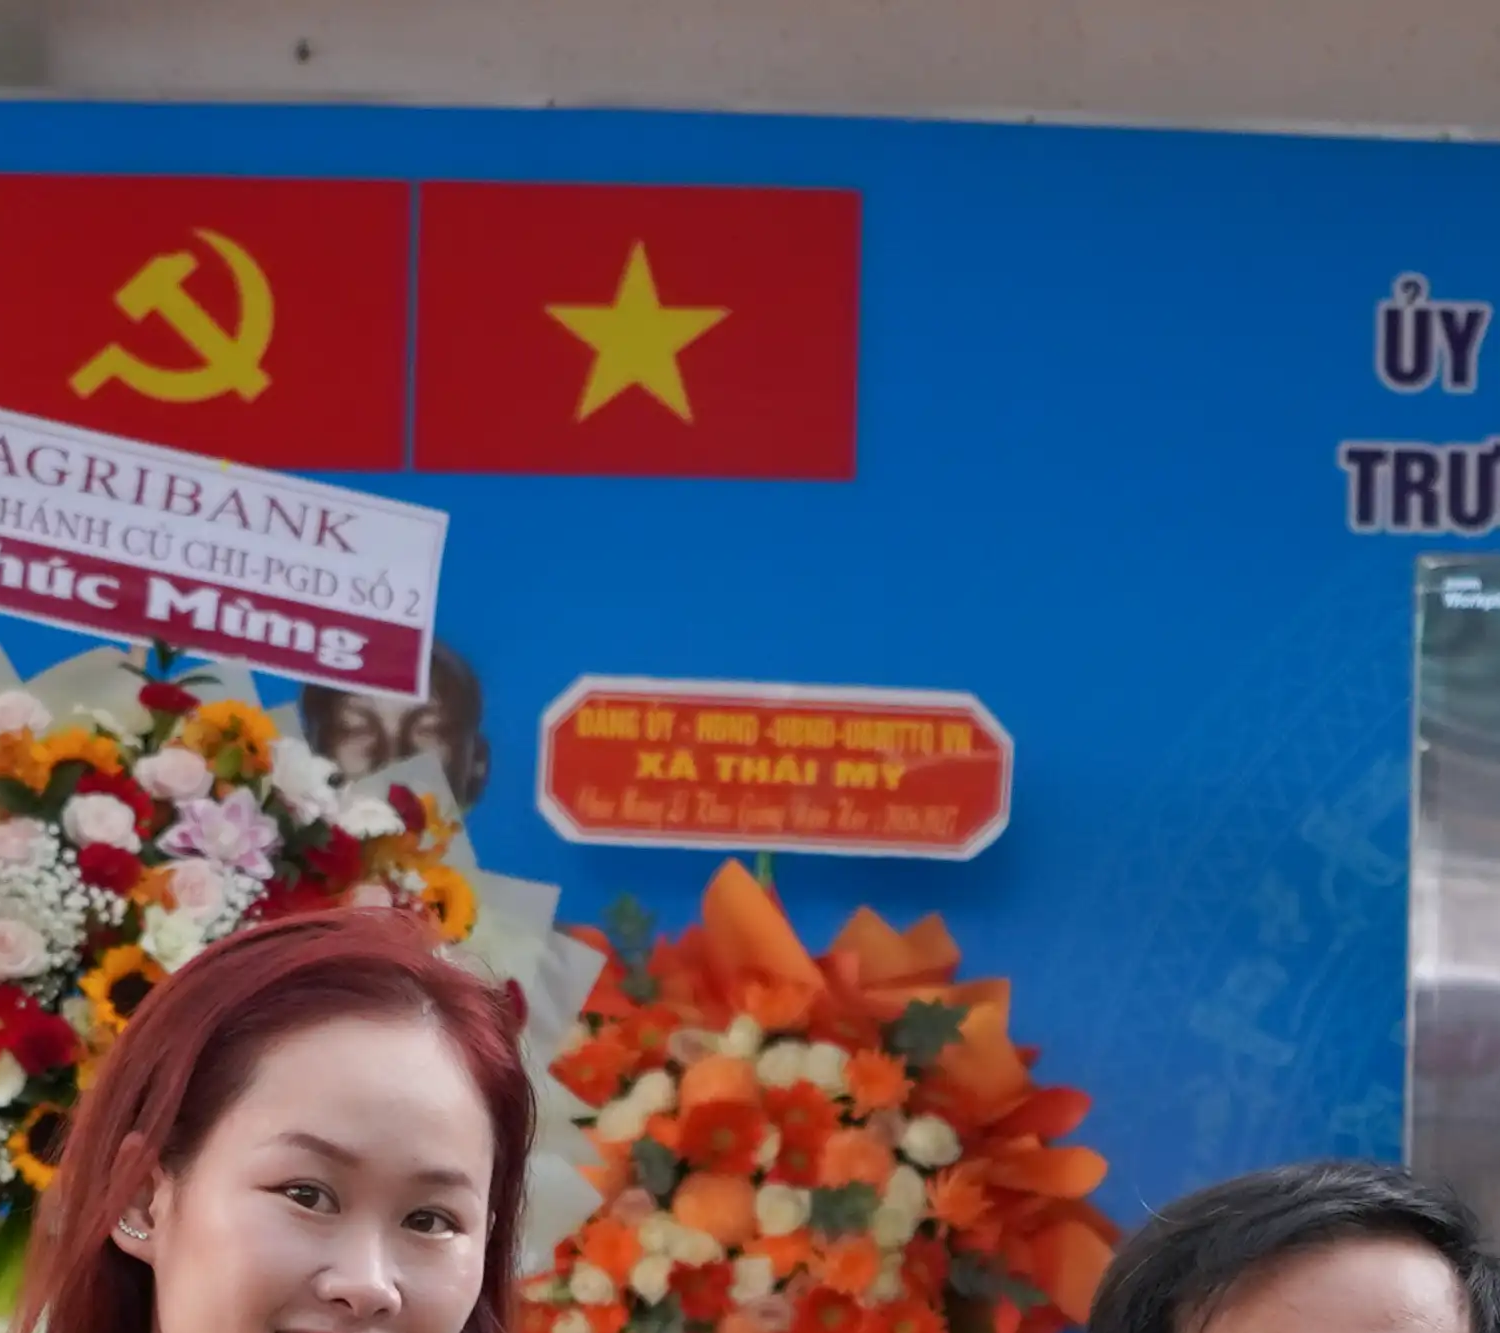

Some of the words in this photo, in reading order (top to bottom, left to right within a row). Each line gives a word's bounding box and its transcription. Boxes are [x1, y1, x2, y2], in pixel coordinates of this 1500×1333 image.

[1381, 275, 1489, 392] ỦY
[181, 540, 339, 599] CHI-PGD
[404, 589, 421, 617] 2
[145, 576, 370, 671] Mừng
[715, 753, 817, 785] THÁI
